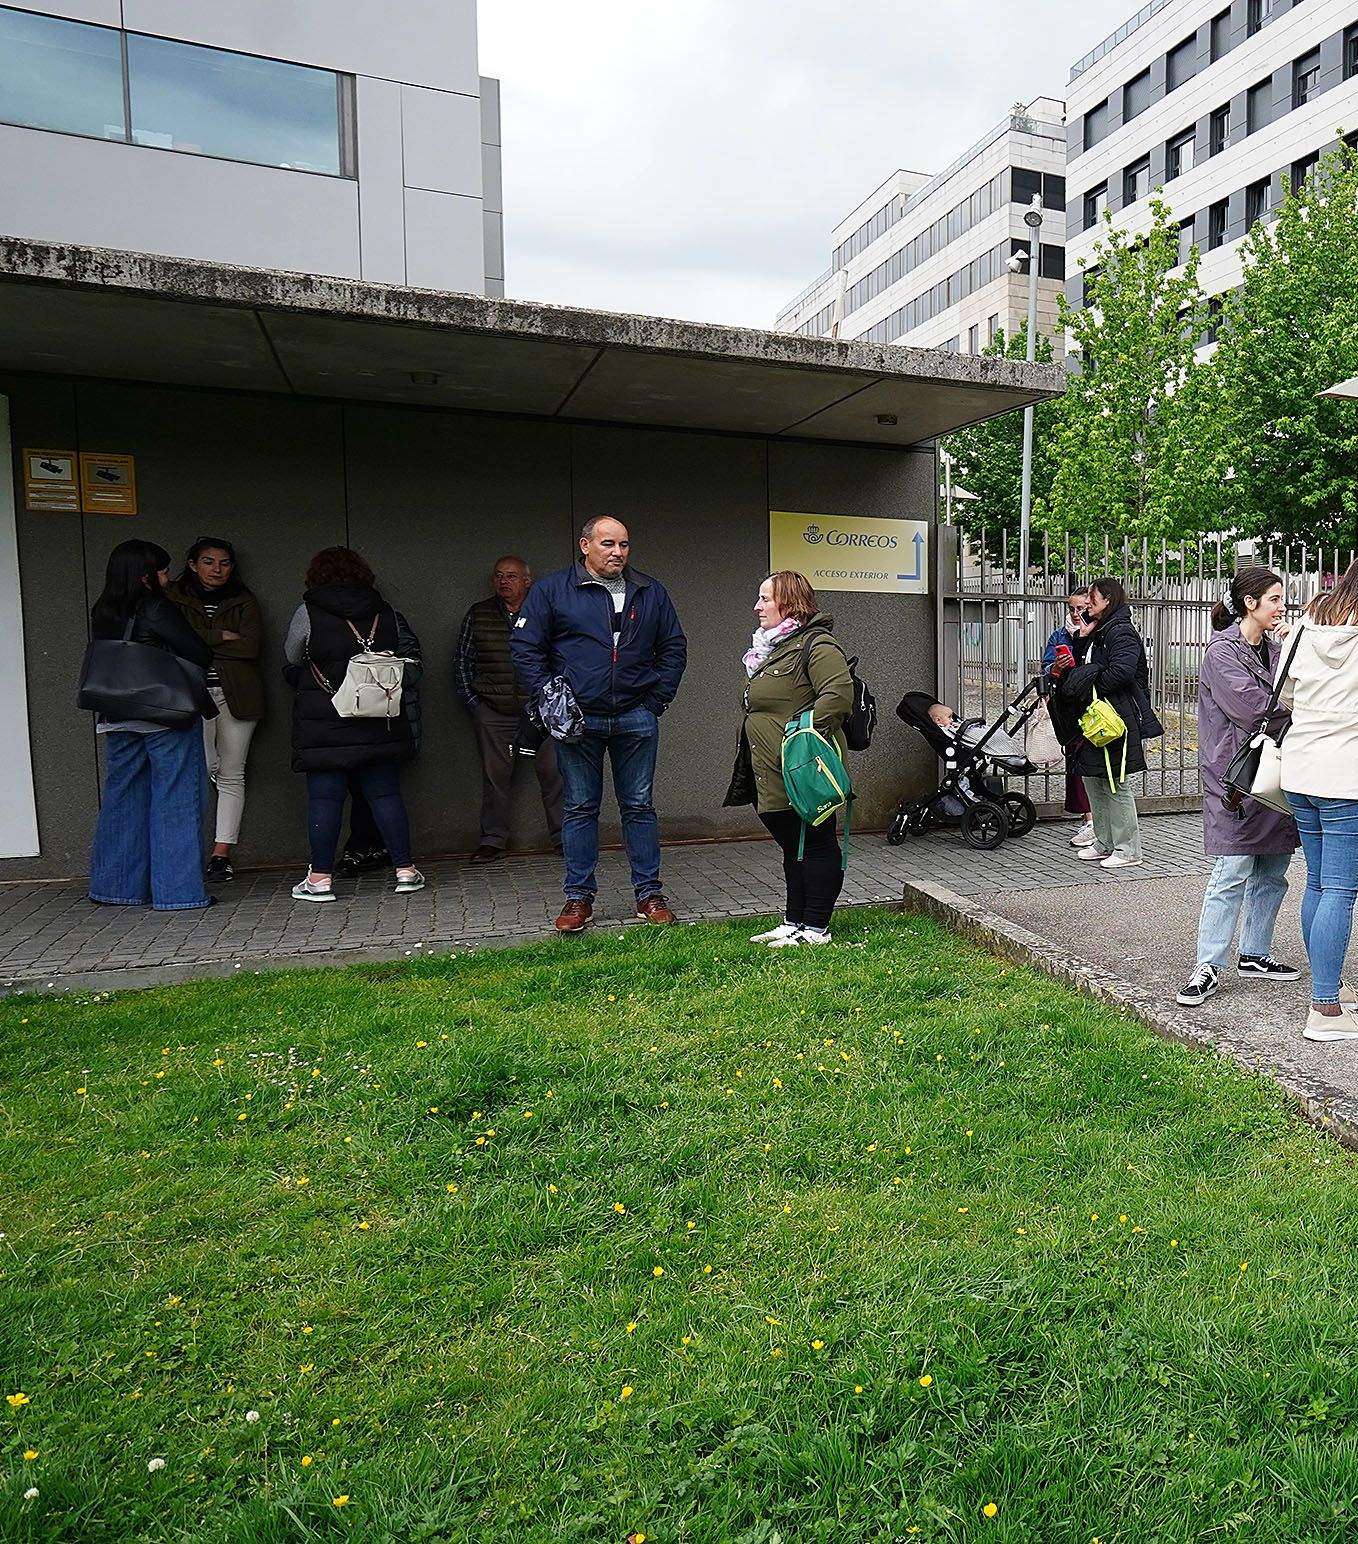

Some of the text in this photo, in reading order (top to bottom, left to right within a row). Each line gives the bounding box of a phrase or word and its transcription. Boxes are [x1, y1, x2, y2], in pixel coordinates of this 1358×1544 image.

[826, 529, 898, 549] CORREOS
[814, 570, 889, 580] ACCESO EXTERIOR
